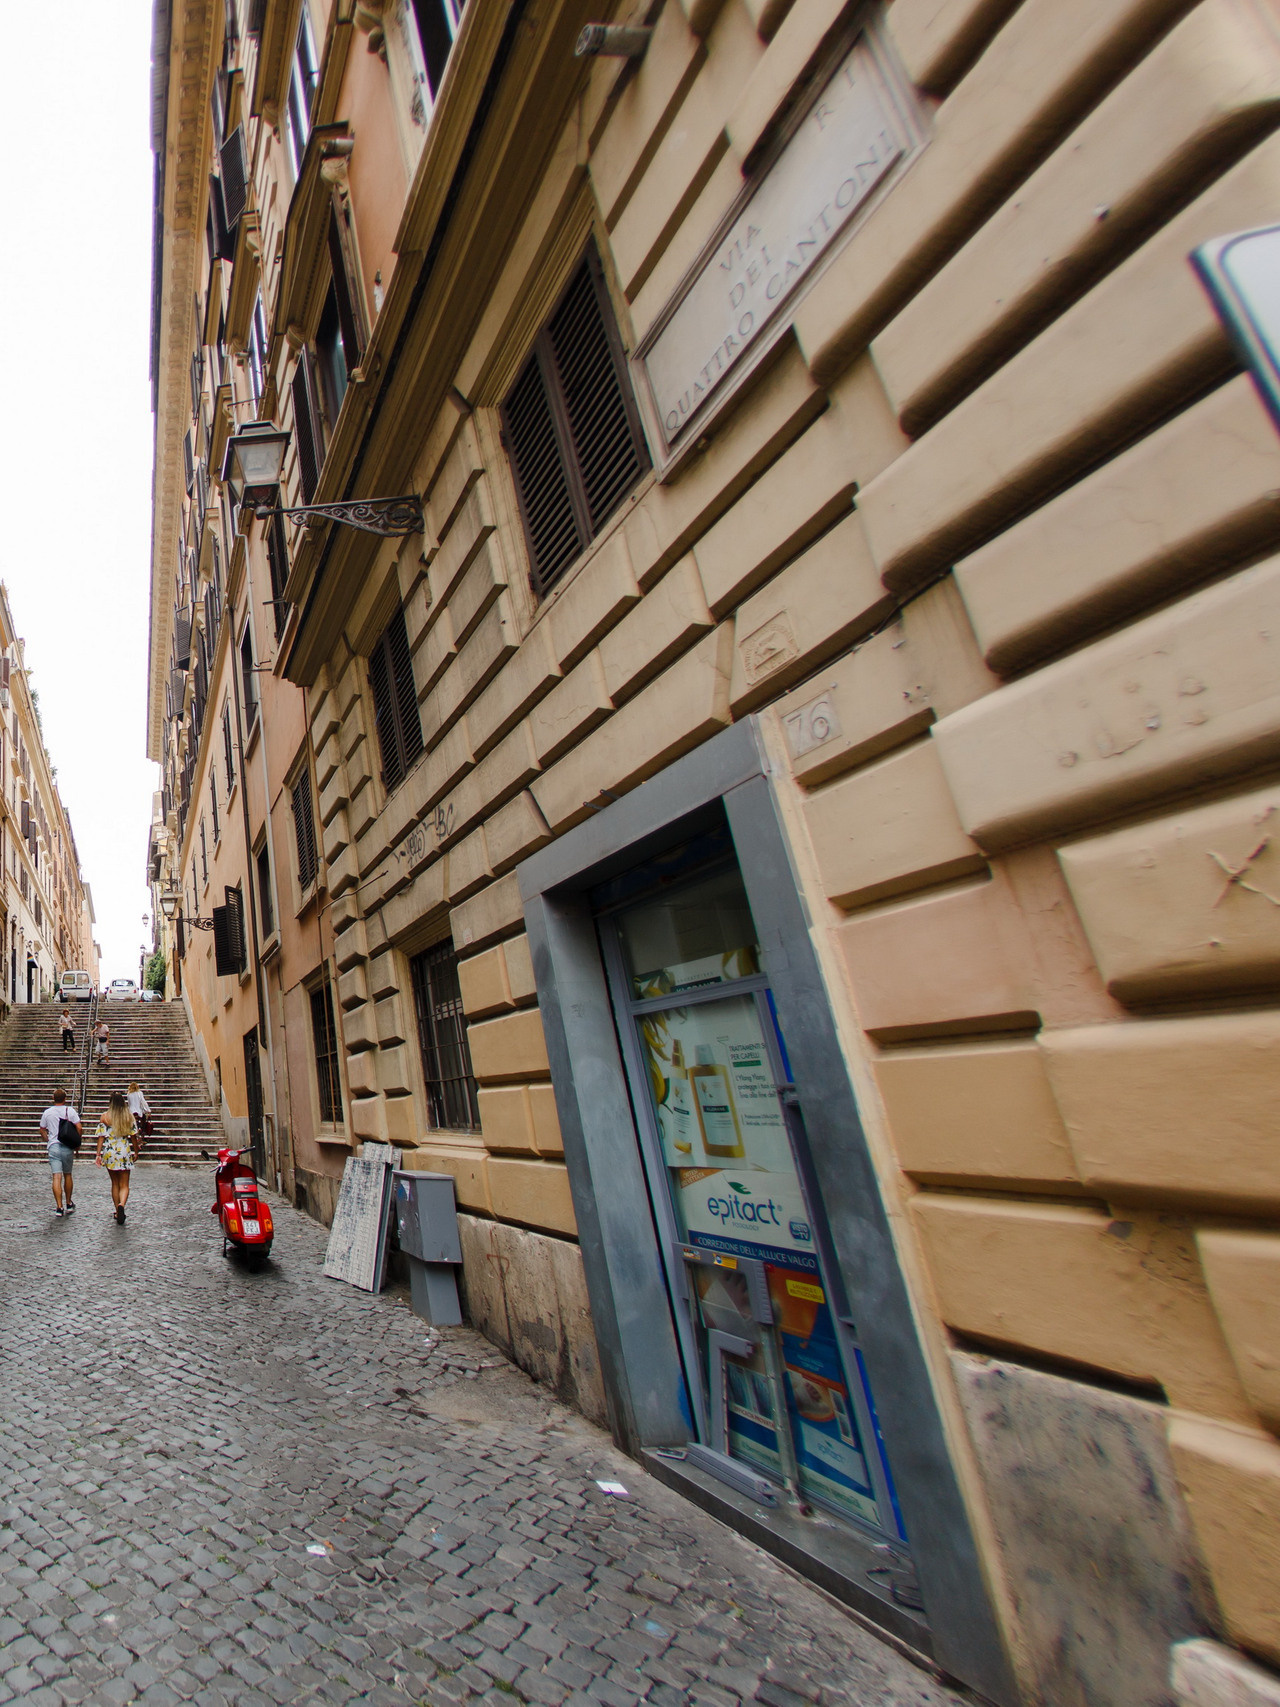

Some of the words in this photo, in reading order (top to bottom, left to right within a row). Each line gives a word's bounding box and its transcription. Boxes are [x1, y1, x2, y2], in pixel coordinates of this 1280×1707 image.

[719, 224, 761, 271] VIA
[665, 311, 755, 432] QUATTRO
[765, 129, 894, 301] CANTONI
[729, 245, 772, 310] DEI
[787, 701, 830, 756] 76
[707, 1194, 780, 1226] epitact
[698, 1236, 739, 1252] CORREZIONE
[788, 1254, 817, 1268] VALGO
